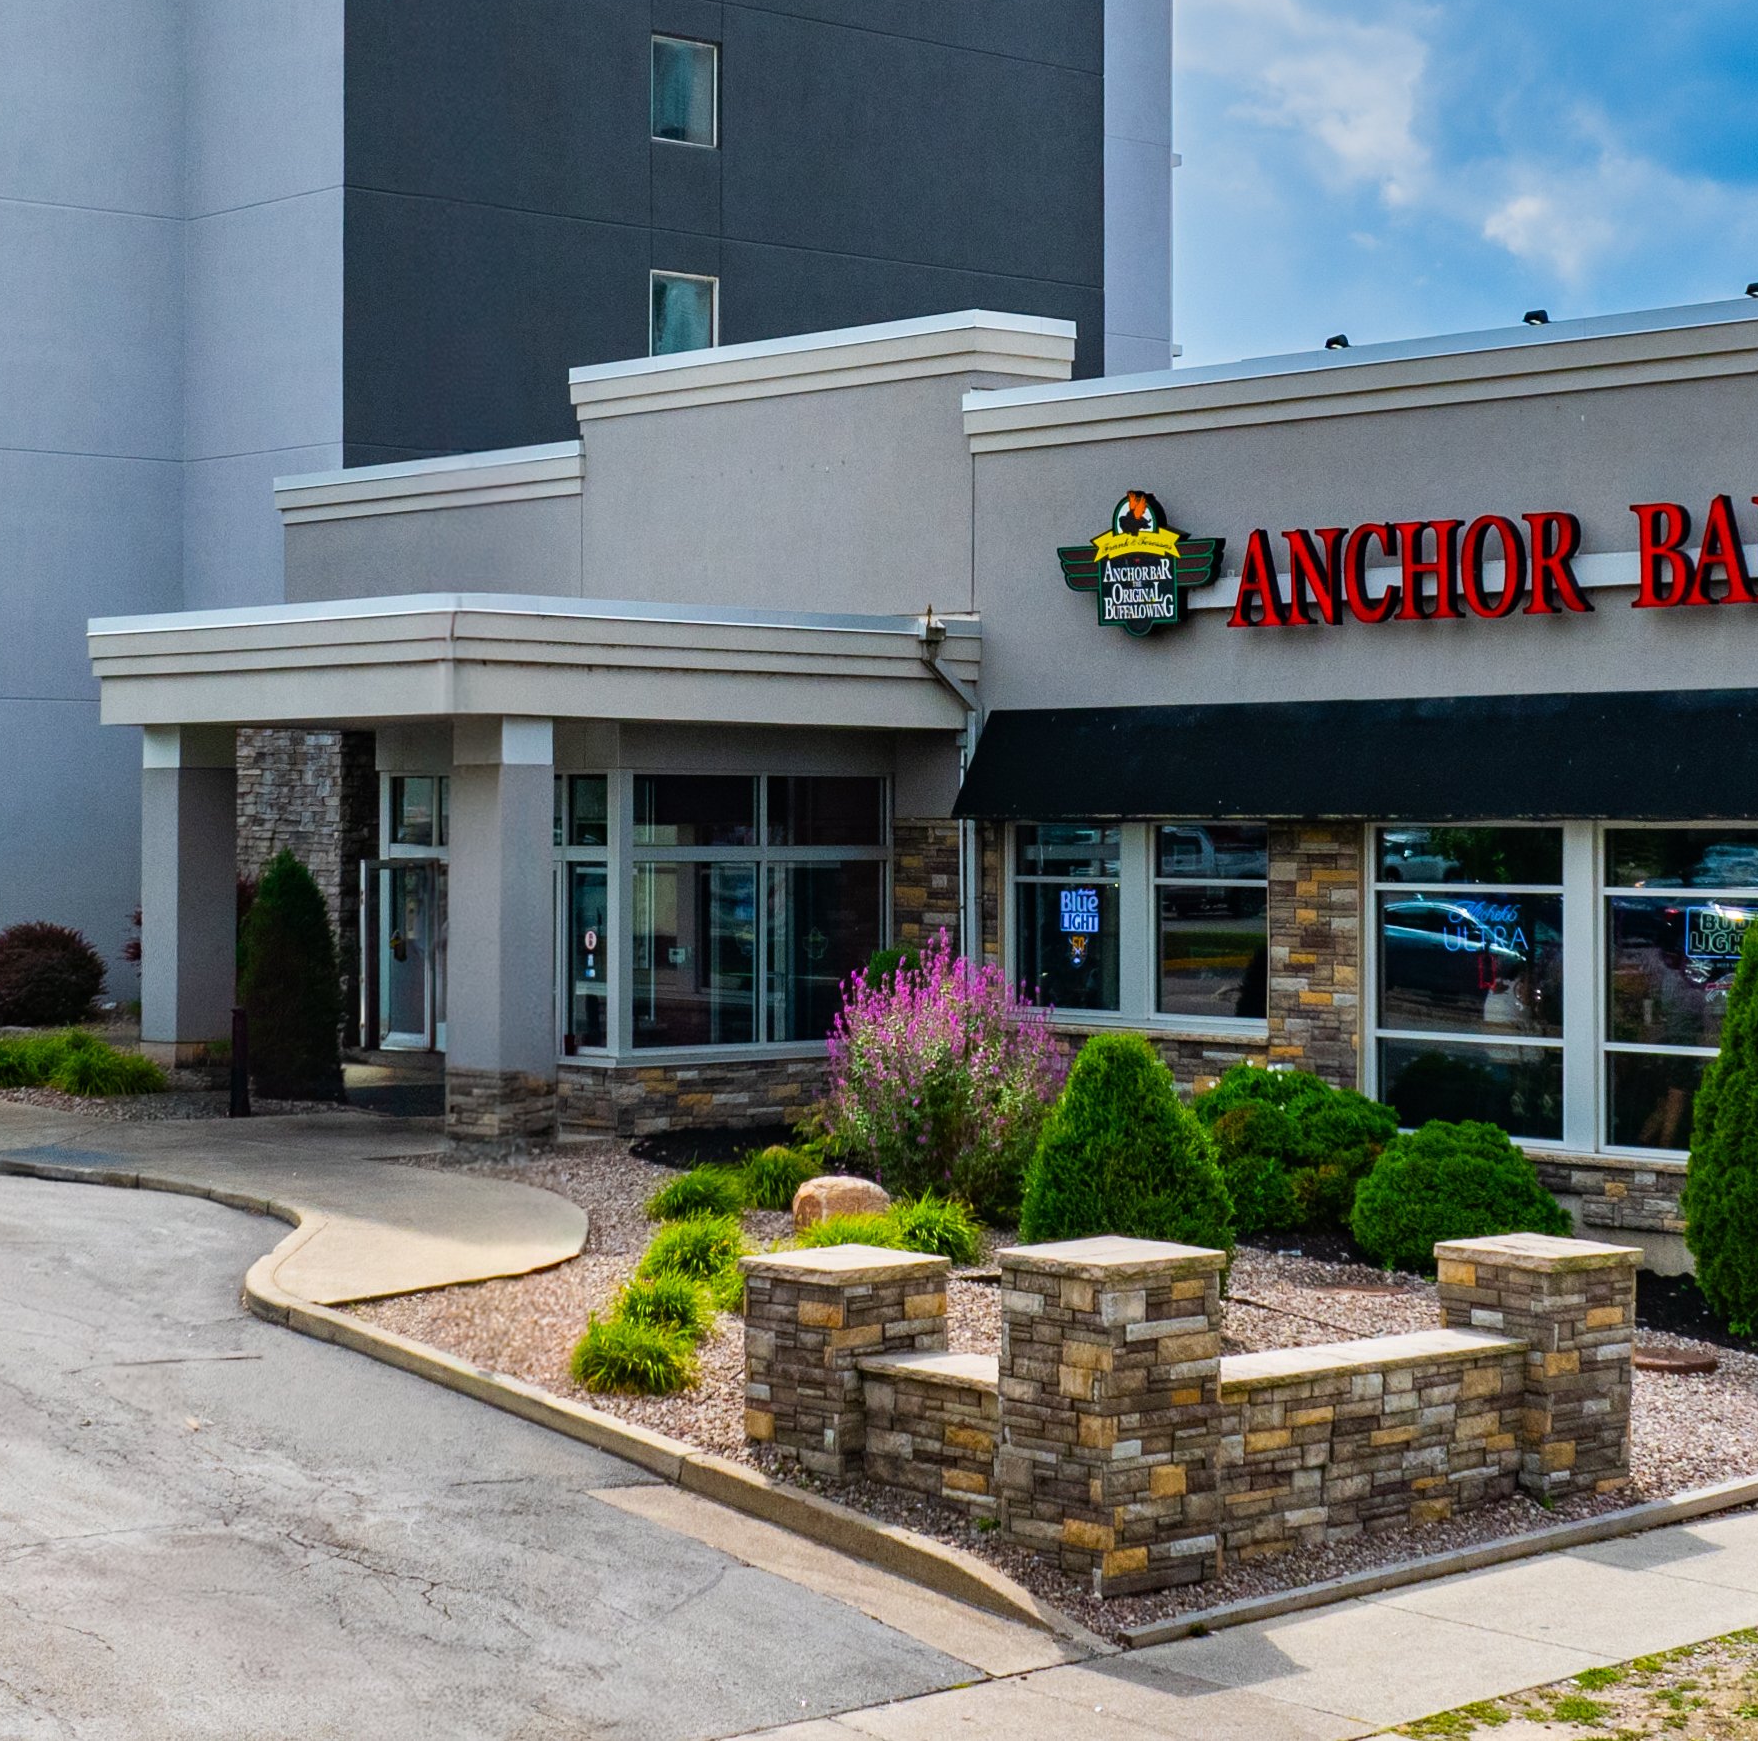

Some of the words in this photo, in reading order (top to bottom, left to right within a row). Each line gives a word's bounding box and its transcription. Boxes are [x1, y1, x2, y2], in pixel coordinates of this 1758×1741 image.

[1227, 512, 1595, 628] ANCHOR
[1112, 581, 1164, 605] ORIGINAL
[1060, 889, 1099, 912] Blue
[1061, 913, 1099, 931] LIGHT
[1700, 911, 1751, 932] BUD
[1443, 925, 1529, 952] ULTRA
[1690, 931, 1746, 954] LIGH
